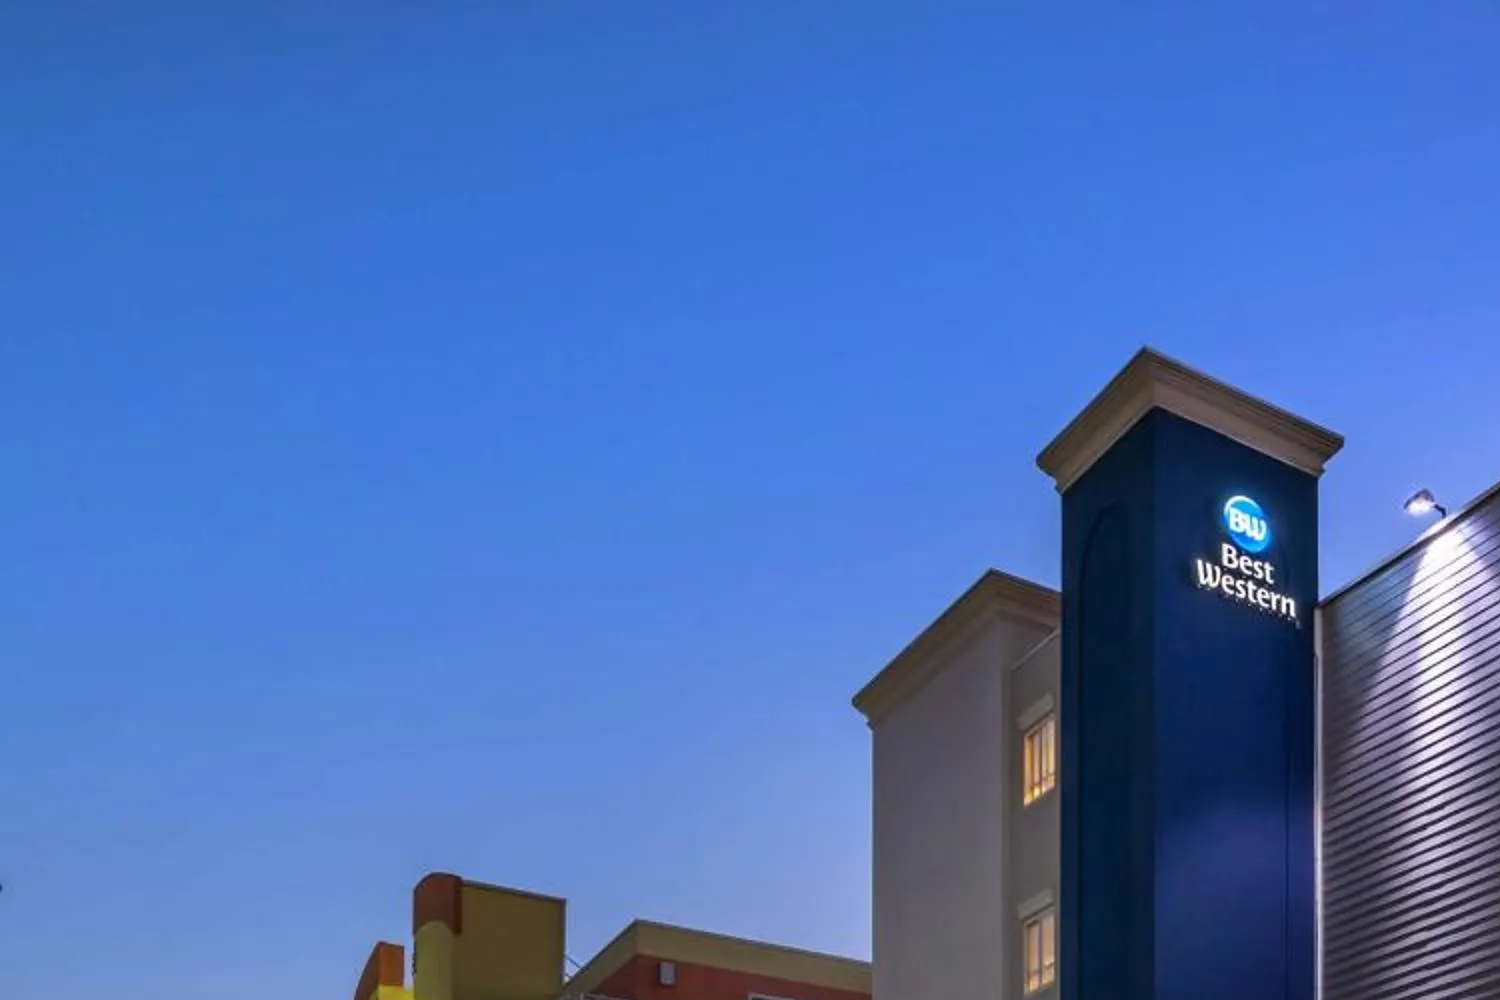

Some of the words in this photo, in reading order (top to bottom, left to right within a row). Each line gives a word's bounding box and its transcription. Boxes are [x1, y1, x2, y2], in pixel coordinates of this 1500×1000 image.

[1230, 507, 1266, 541] BW
[1222, 543, 1274, 584] Best
[1197, 559, 1296, 618] Western
